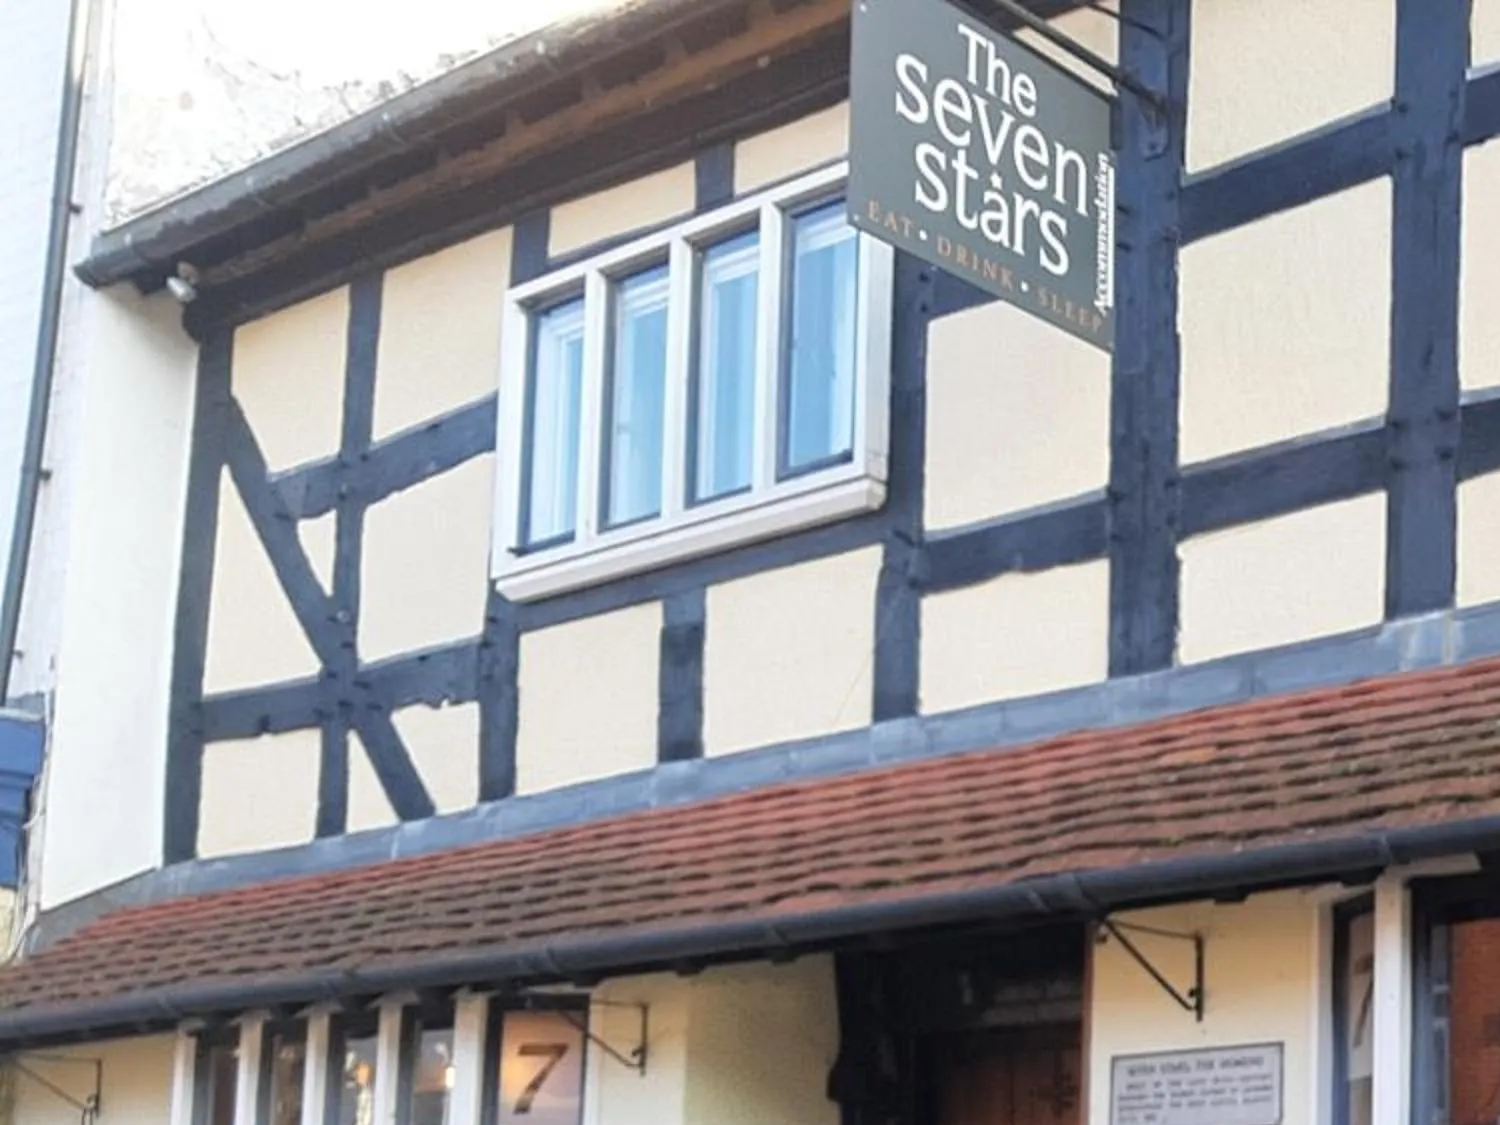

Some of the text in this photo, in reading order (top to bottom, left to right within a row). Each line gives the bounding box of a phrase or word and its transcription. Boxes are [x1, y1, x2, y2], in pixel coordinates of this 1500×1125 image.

[958, 24, 1037, 117] The
[867, 199, 914, 238] EAT
[936, 236, 1015, 291] DRINK
[513, 1042, 568, 1115] 7
